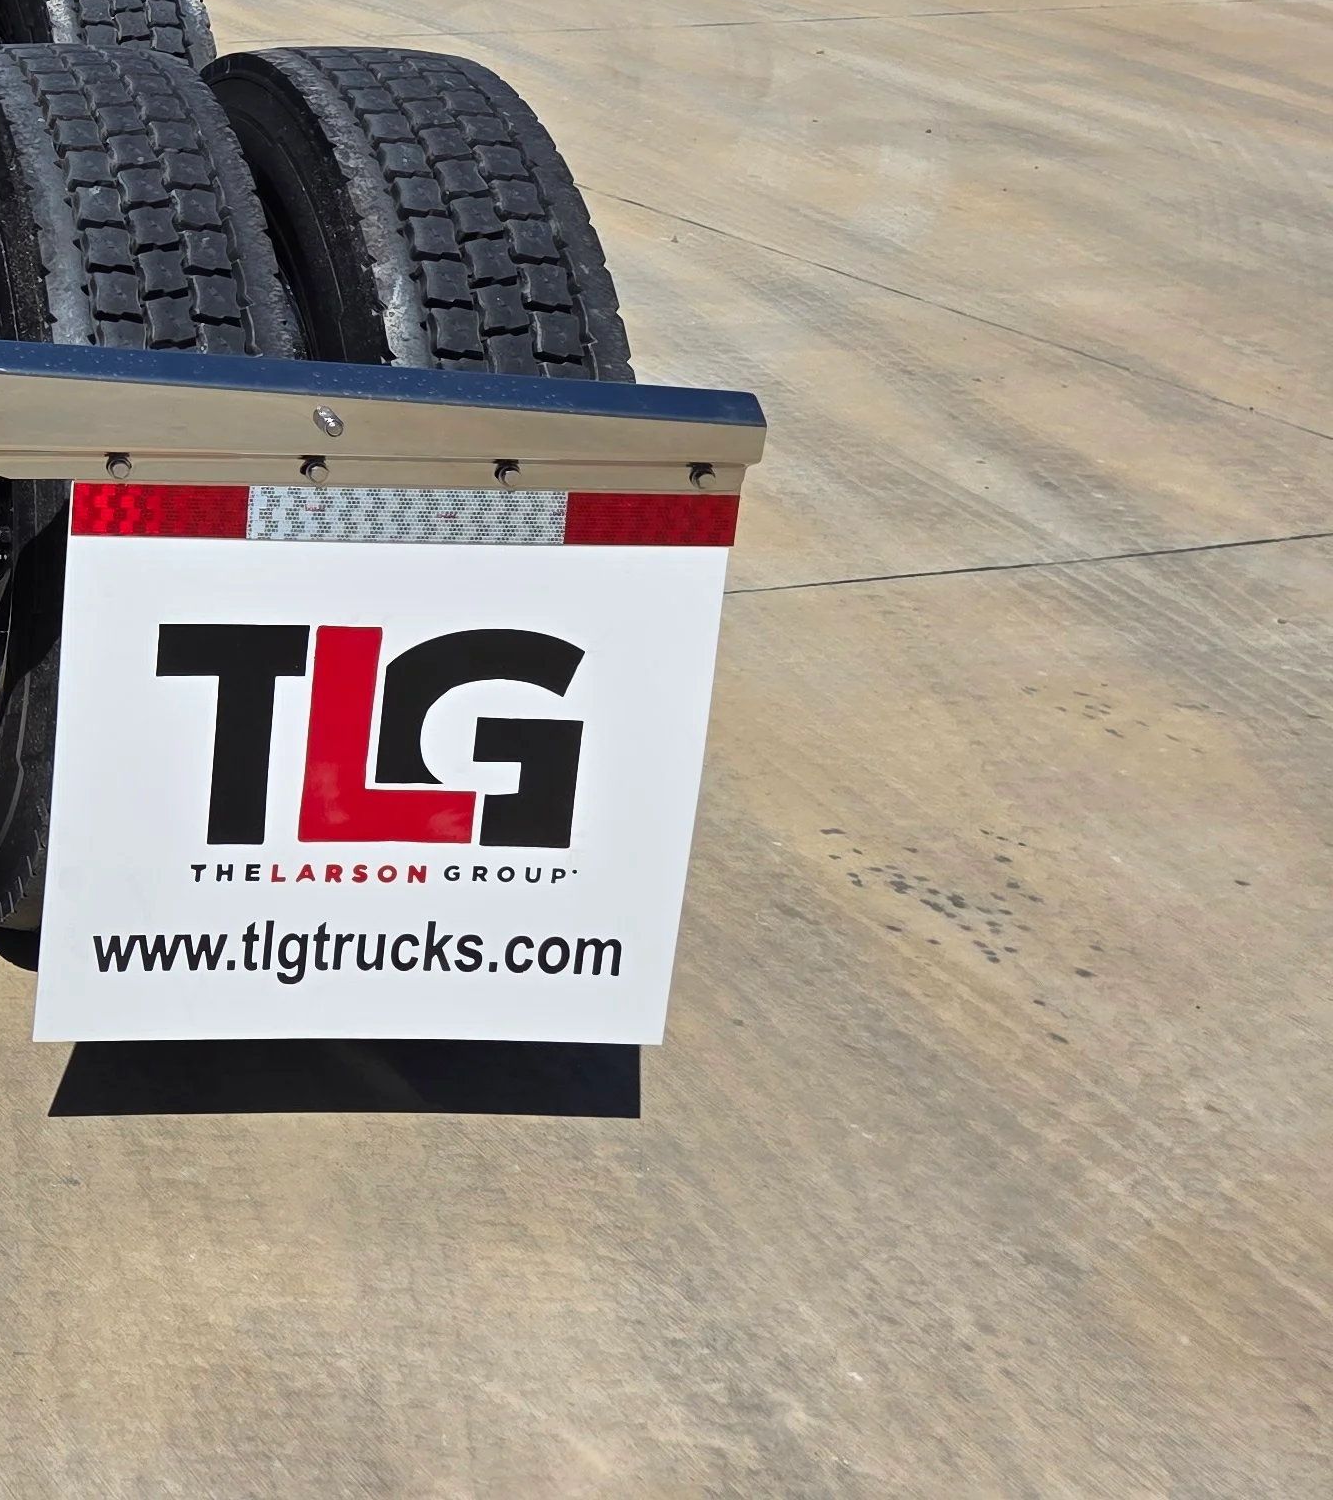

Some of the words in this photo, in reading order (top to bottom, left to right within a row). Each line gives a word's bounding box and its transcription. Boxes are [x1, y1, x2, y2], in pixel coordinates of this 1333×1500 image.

[155, 623, 586, 849] TLG
[443, 863, 568, 884] GROUP
[92, 920, 622, 985] www.tlgtrucks.com
